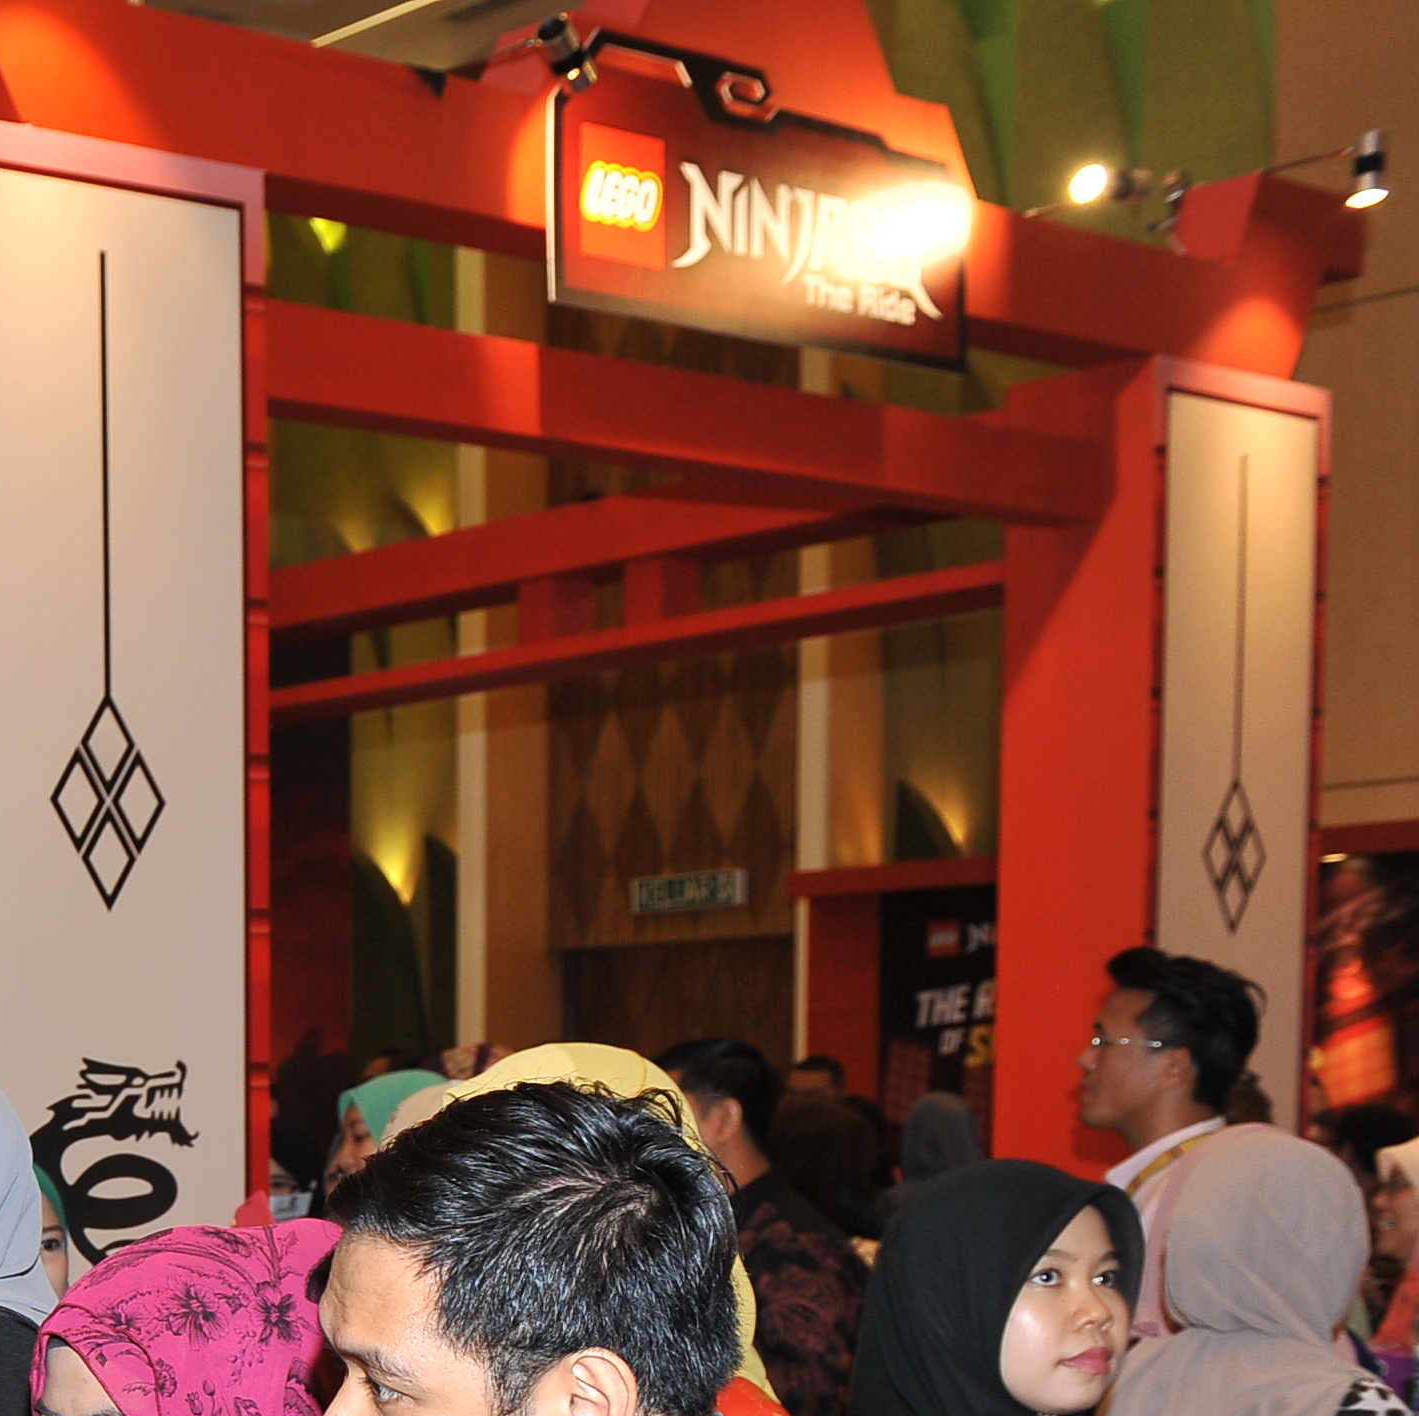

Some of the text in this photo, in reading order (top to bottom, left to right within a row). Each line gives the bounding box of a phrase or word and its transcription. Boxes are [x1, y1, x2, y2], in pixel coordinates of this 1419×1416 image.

[582, 161, 662, 229] LEGO
[804, 273, 917, 326] The Ride
[916, 983, 972, 1029] THE
